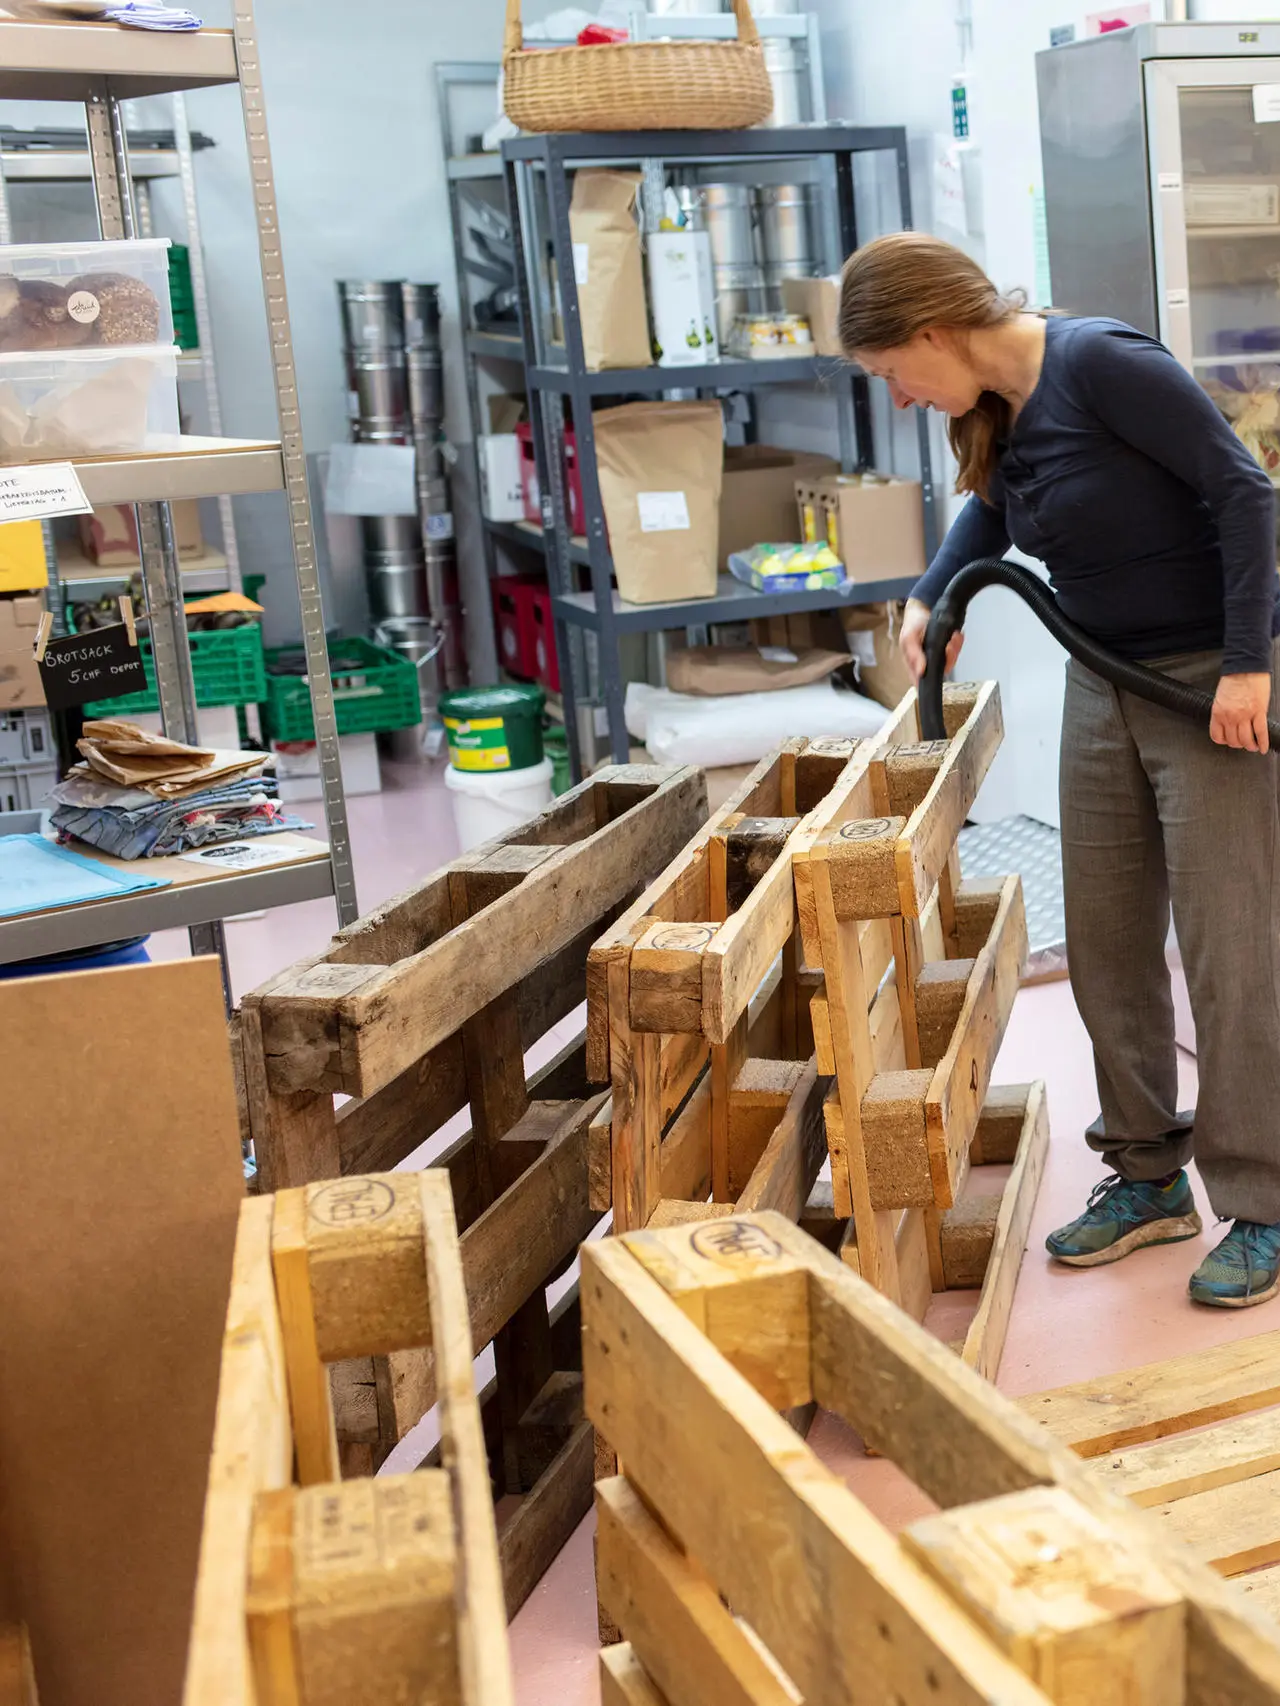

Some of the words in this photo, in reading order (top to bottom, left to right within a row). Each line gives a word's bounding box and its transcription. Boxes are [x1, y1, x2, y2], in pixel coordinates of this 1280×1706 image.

[45, 645, 112, 667] BROTSACK
[68, 669, 81, 683] 5
[83, 669, 101, 681] CHF
[110, 662, 139, 674] DEPOT
